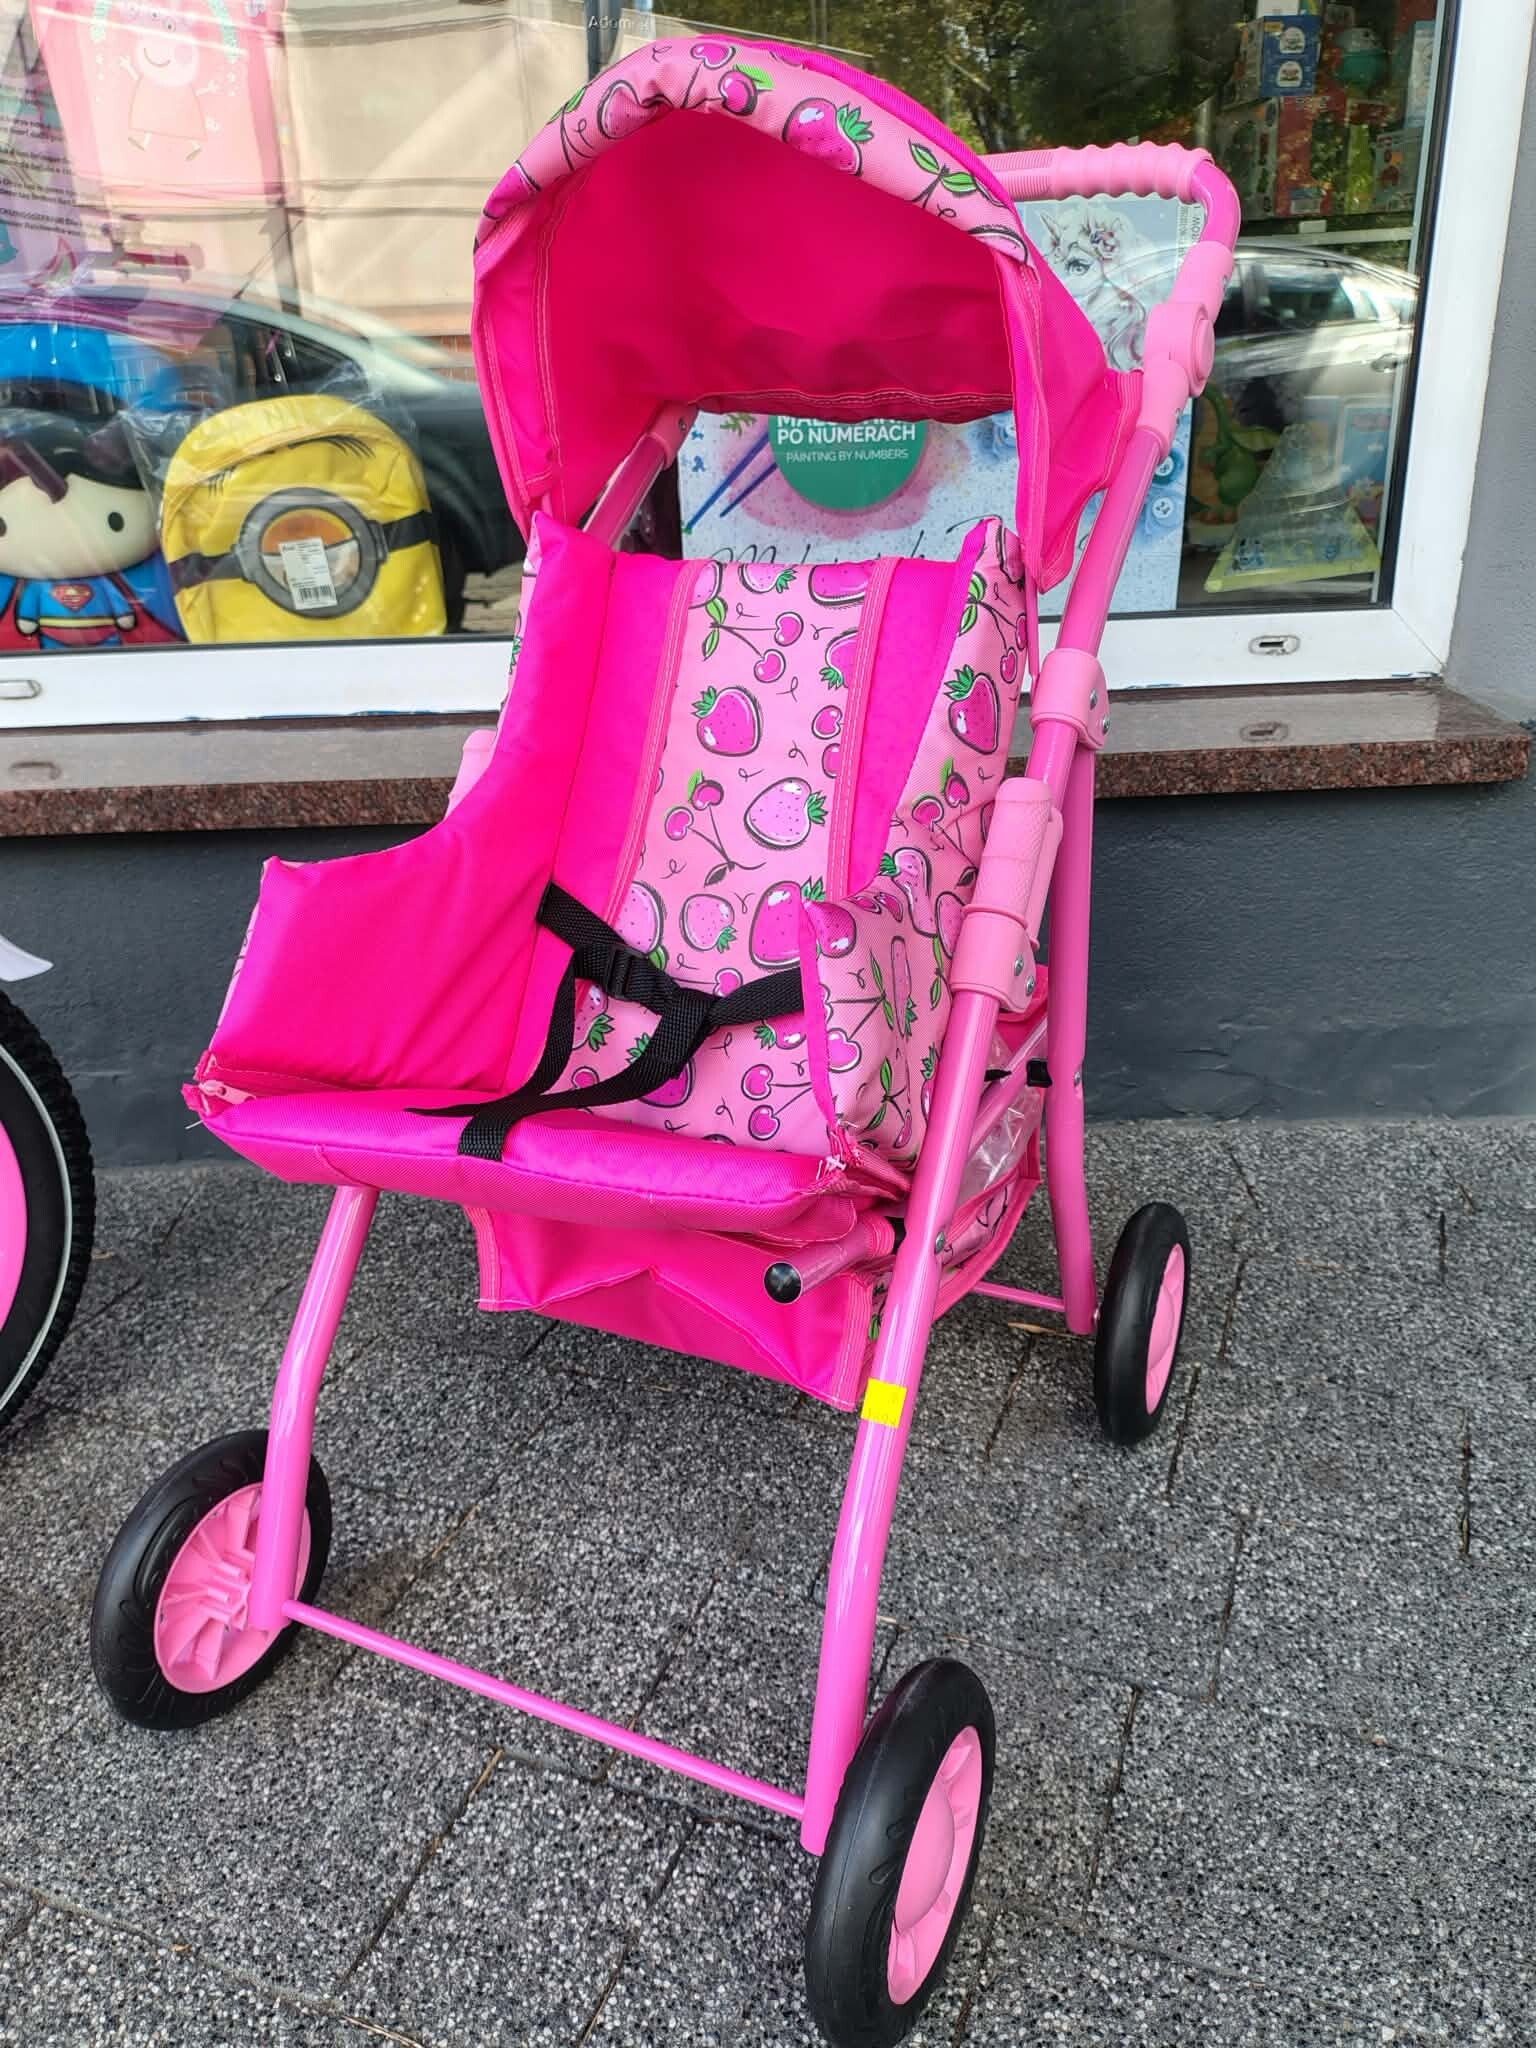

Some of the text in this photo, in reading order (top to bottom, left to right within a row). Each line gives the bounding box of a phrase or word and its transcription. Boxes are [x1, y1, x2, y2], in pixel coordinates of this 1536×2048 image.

[777, 425, 916, 444] PO NUMERACH
[786, 448, 909, 463] PAINTING BY NUMBERS
